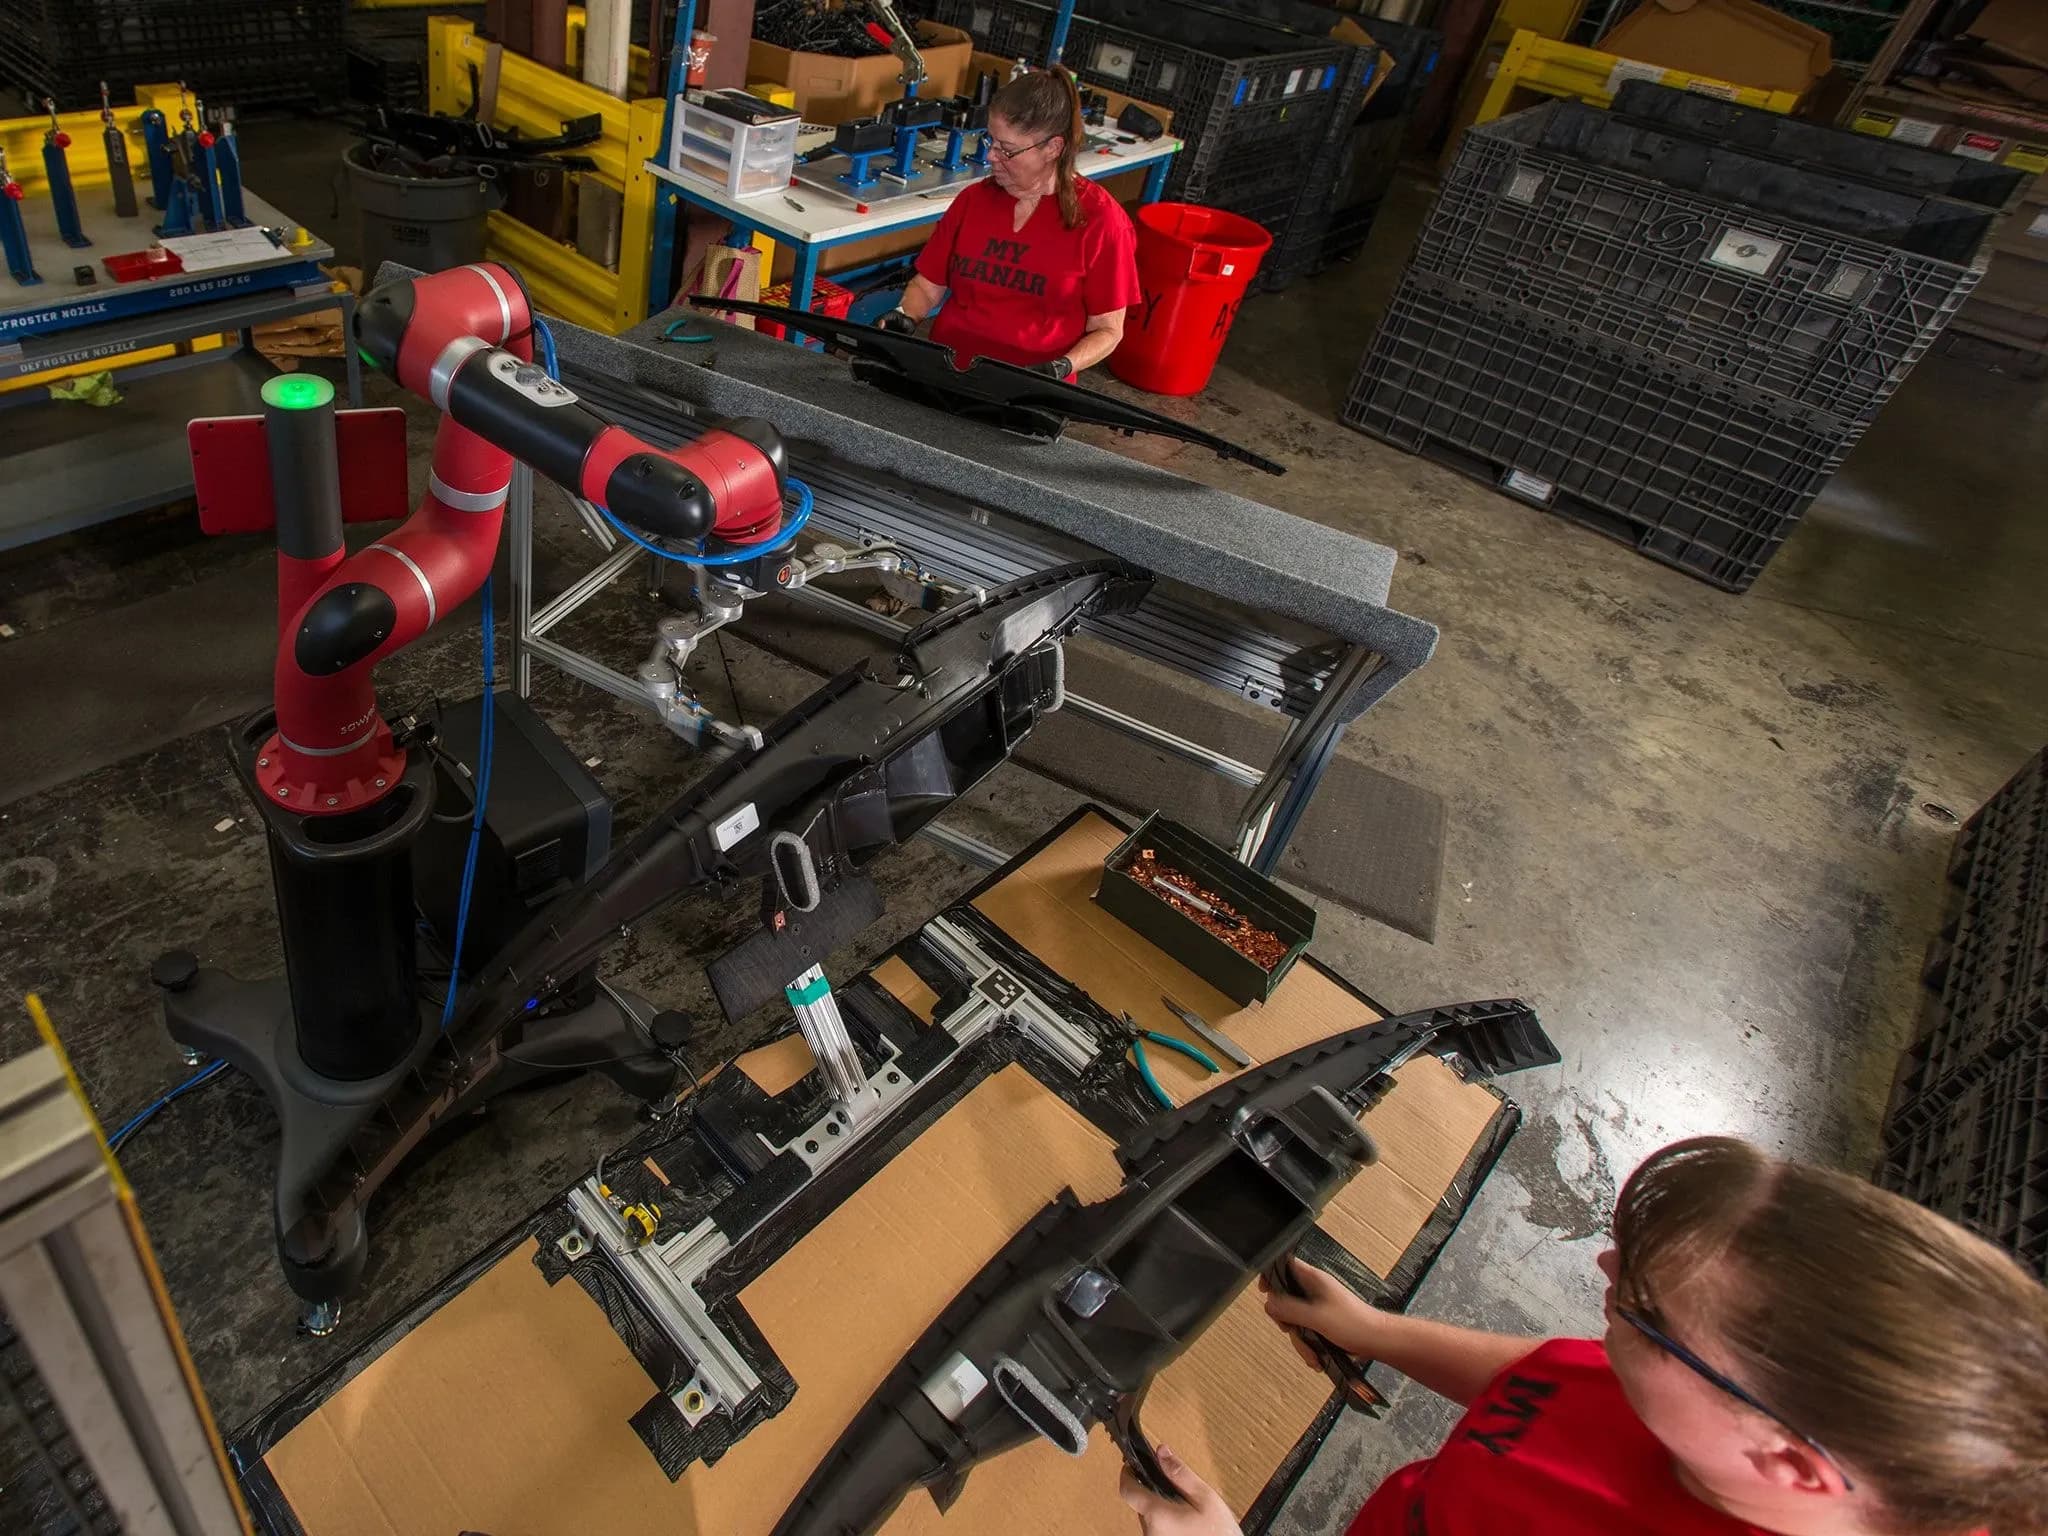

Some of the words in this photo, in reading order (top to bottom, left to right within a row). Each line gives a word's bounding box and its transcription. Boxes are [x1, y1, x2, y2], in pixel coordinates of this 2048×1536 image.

[983, 237, 1030, 264] MY
[169, 287, 191, 297] 280
[193, 281, 214, 293] LBS
[217, 277, 233, 288] 127
[61, 302, 106, 319] NOZZLE
[19, 350, 90, 373] DEFROSTER
[92, 339, 137, 356] NOZZLE
[1465, 1375, 1558, 1456] MY
